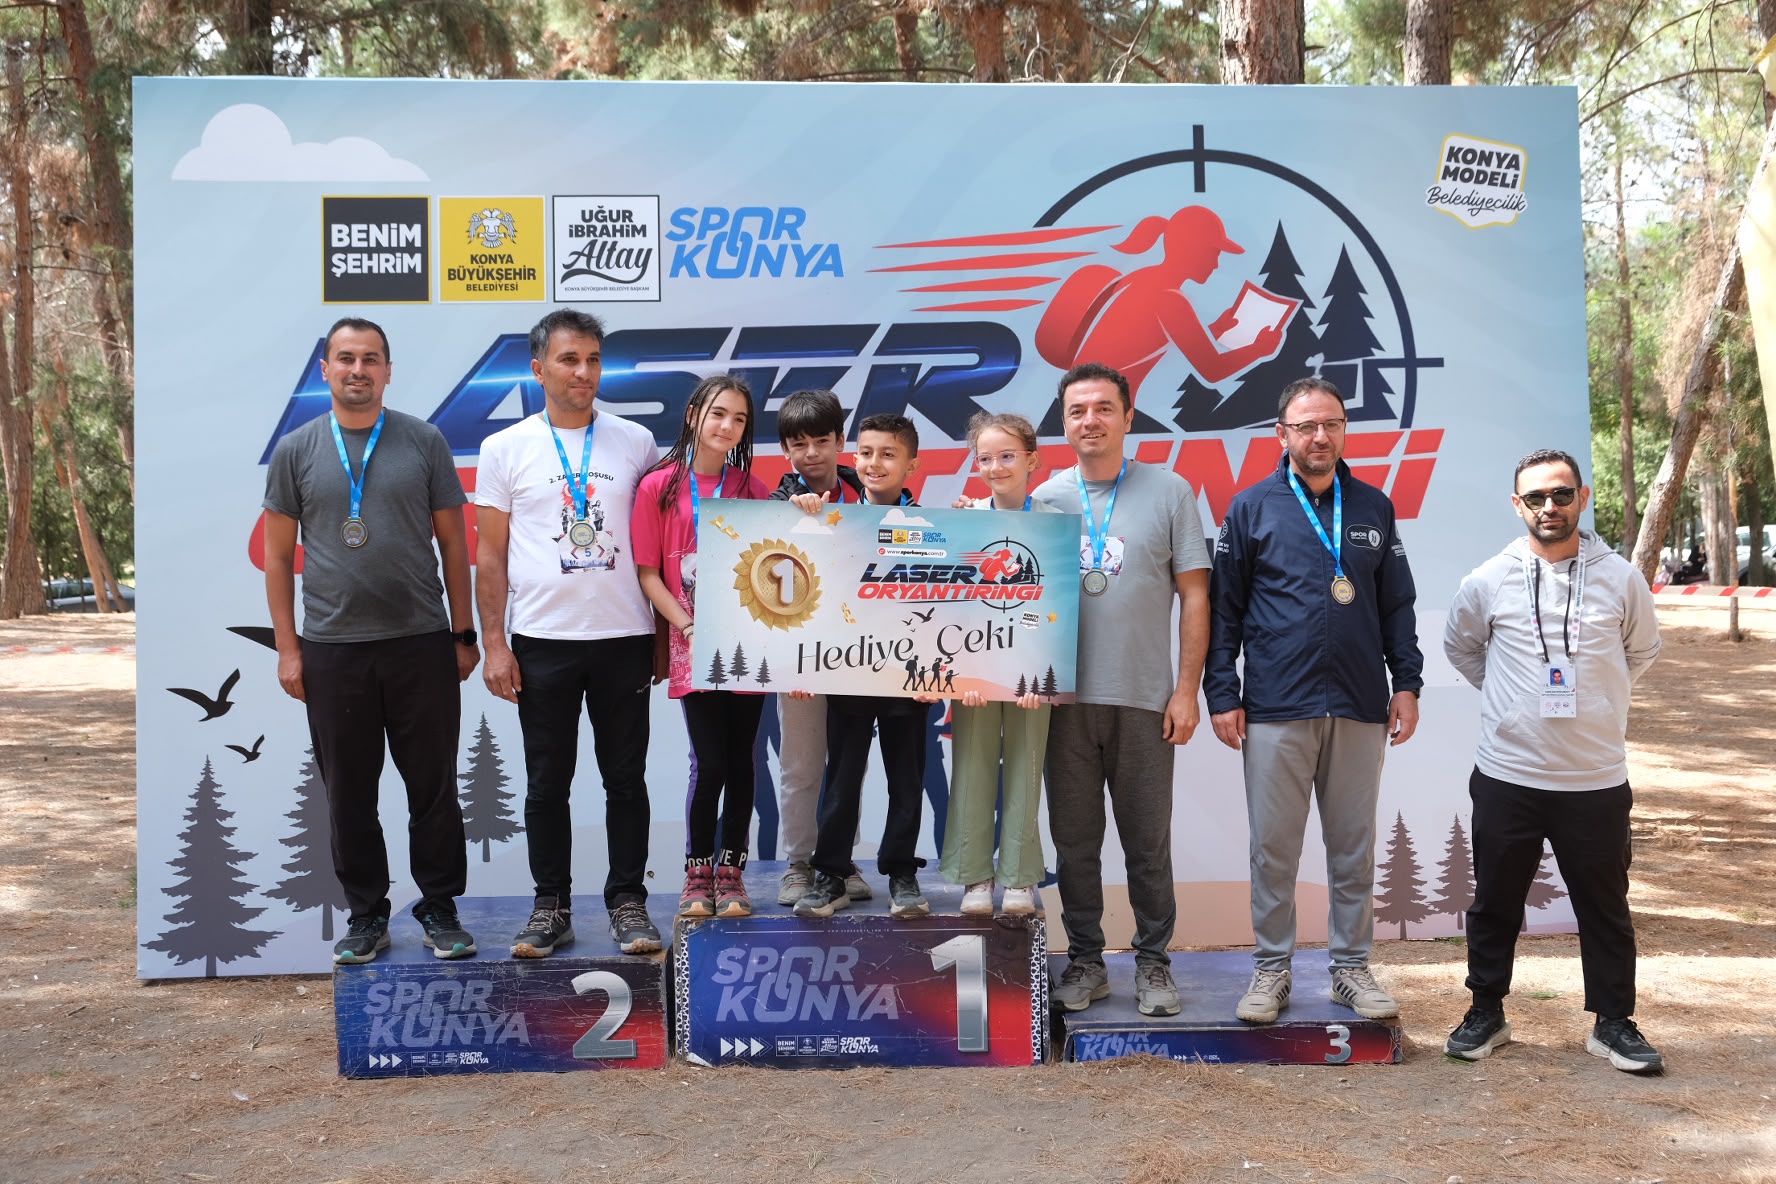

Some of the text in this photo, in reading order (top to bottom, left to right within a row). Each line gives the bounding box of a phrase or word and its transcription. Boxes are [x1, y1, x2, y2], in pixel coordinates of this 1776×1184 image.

[1446, 146, 1520, 171] KONYA
[581, 206, 633, 223] UĞUR
[1427, 186, 1526, 217] Belediyecilik
[665, 206, 806, 249] SPOR
[470, 254, 514, 264] KONYA
[560, 239, 653, 284] Altay
[669, 232, 845, 279] KONYA
[447, 265, 537, 281] BÜYÜKŞEHİR
[466, 283, 519, 292] BELEDİYESİ
[584, 547, 592, 557] 5
[769, 558, 794, 606] 1
[860, 562, 977, 584] LASER
[797, 617, 1014, 674] Hediye Çeki
[711, 946, 859, 997] SPOR
[363, 980, 493, 1027] SPOR
[716, 971, 899, 1023] KONYA
[930, 934, 989, 1052] 1
[368, 1003, 531, 1048] KONYA
[571, 970, 638, 1059] 2
[459, 1051, 483, 1060] SPOR
[840, 1037, 870, 1047] SPOR
[840, 1043, 879, 1054] KONYA
[1324, 1025, 1352, 1062] 3
[460, 1055, 489, 1065] KONYA
